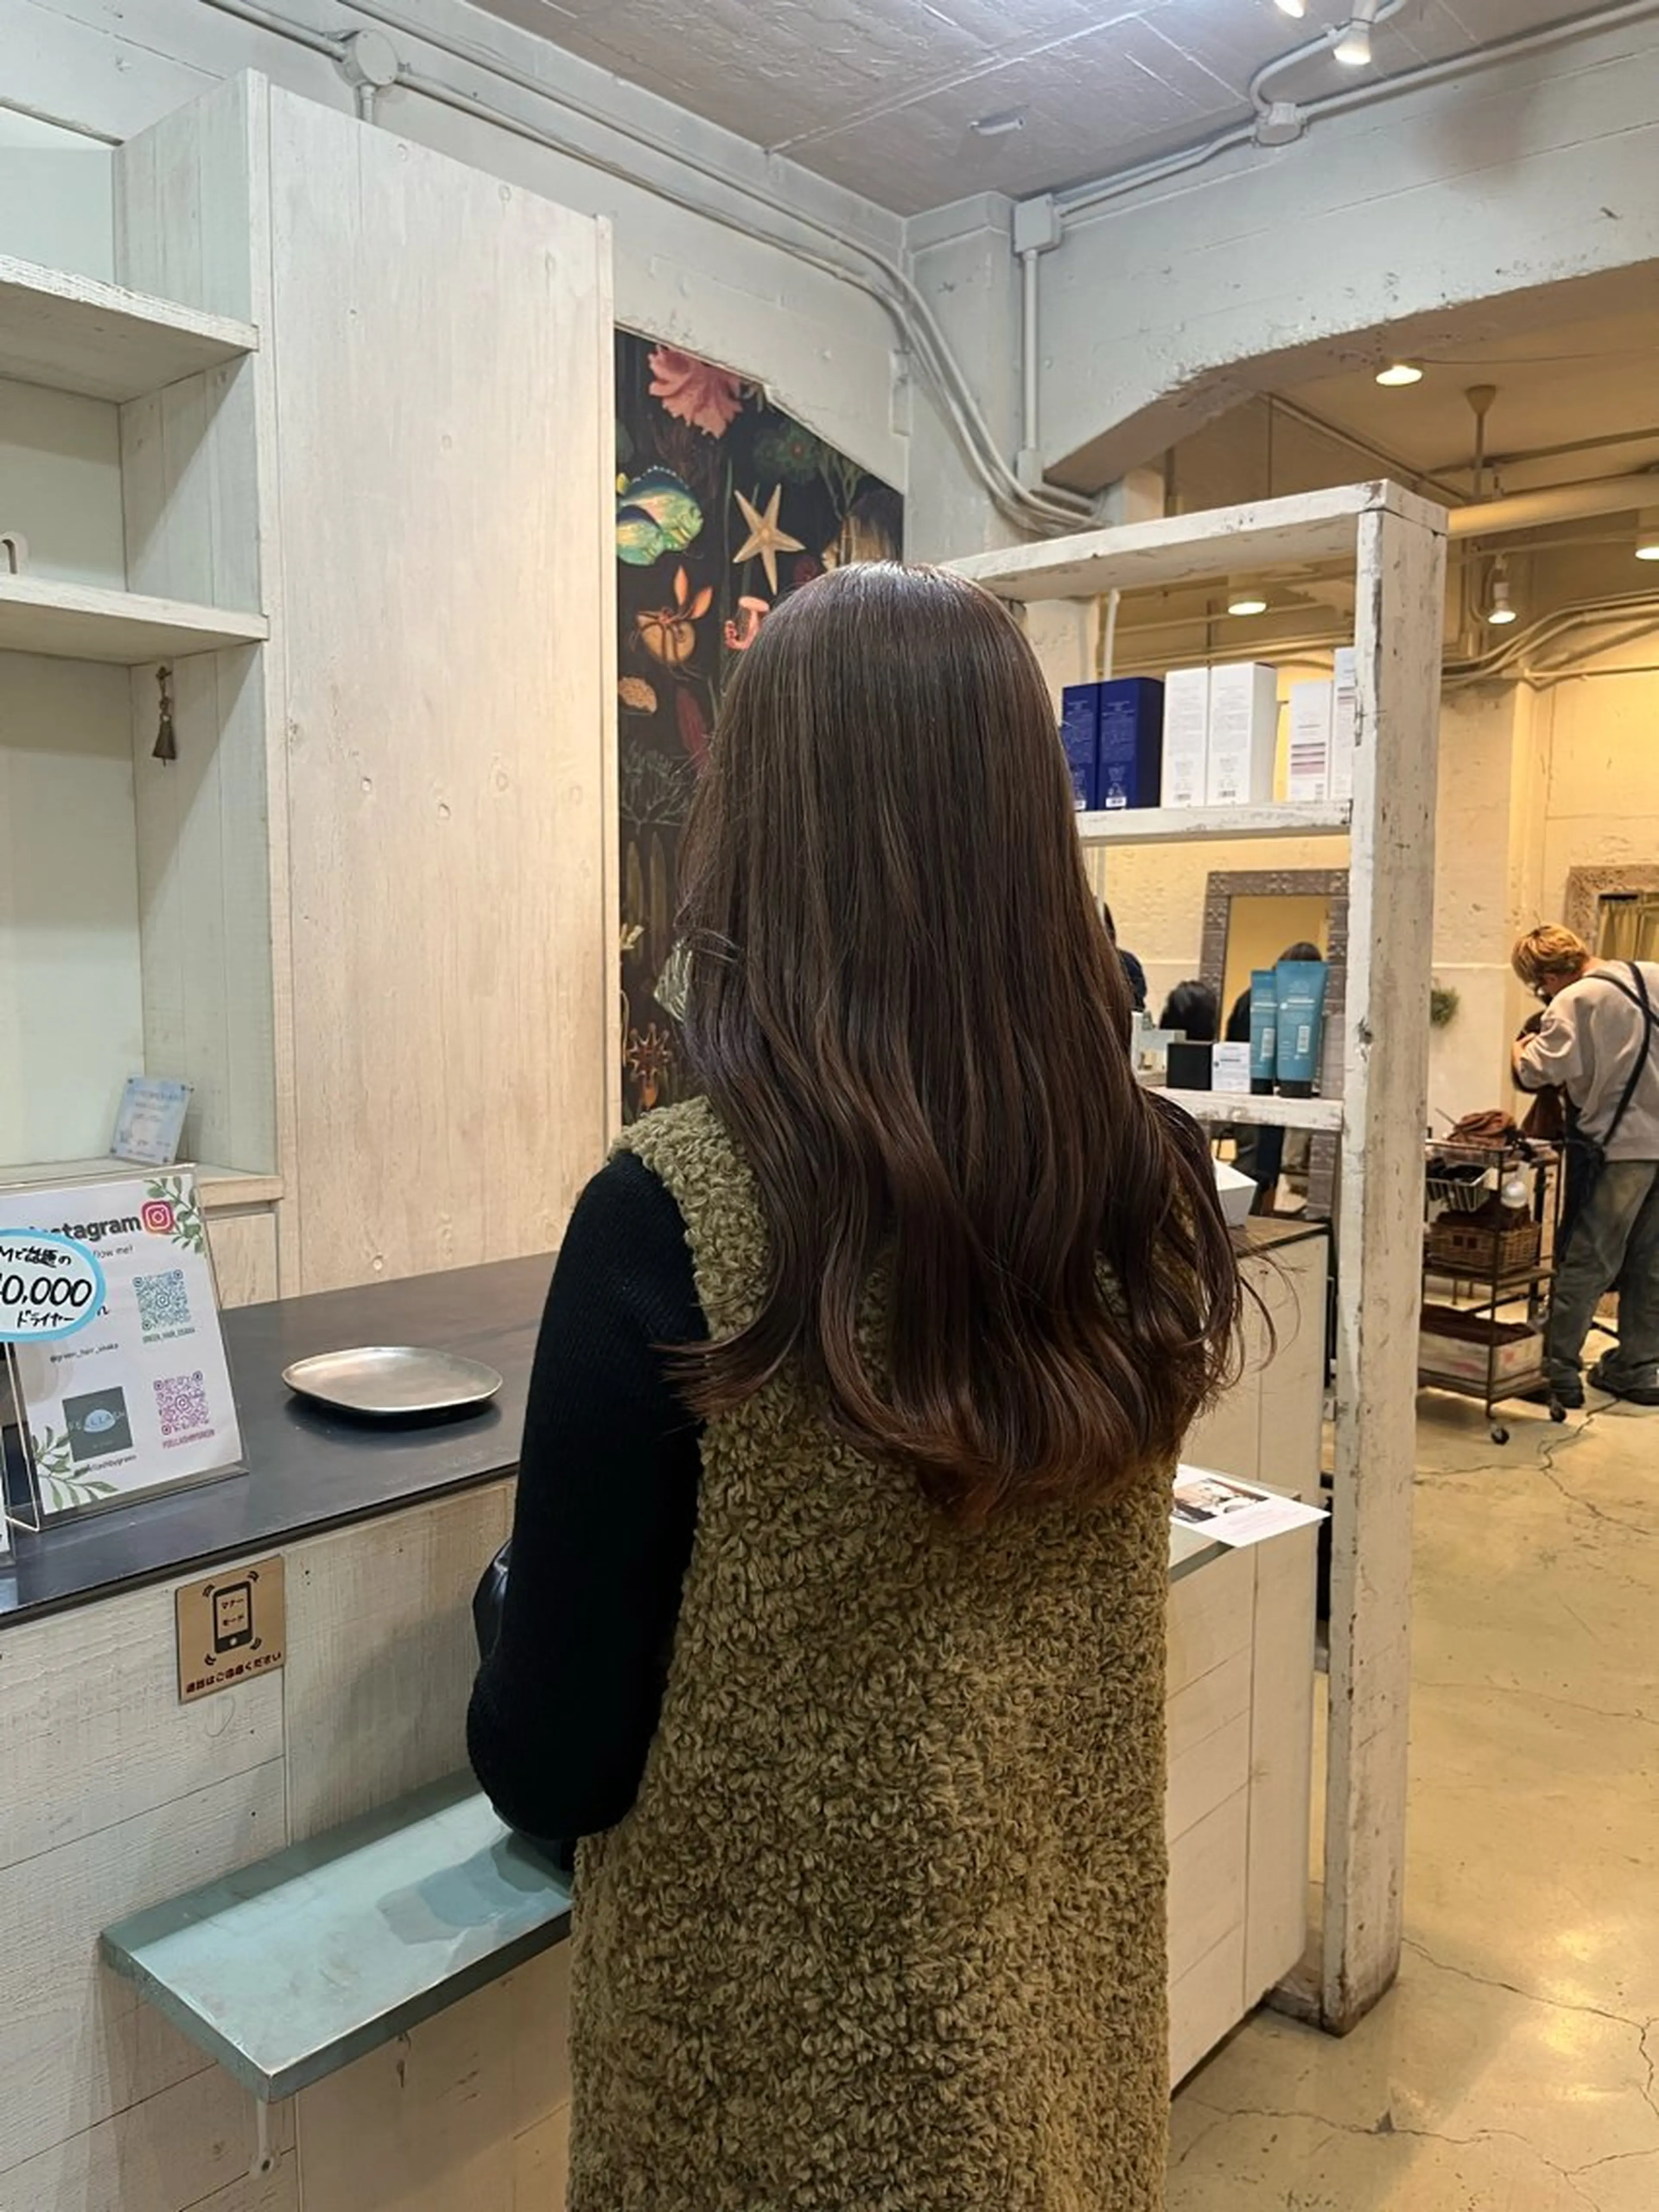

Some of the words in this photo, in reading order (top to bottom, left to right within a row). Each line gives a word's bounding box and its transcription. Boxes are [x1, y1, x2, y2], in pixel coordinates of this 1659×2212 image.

[0, 1273, 92, 1306] 0,000
[17, 1309, 75, 1328] ドライヤー
[221, 1598, 244, 1609] マナー
[222, 1614, 245, 1626] モード
